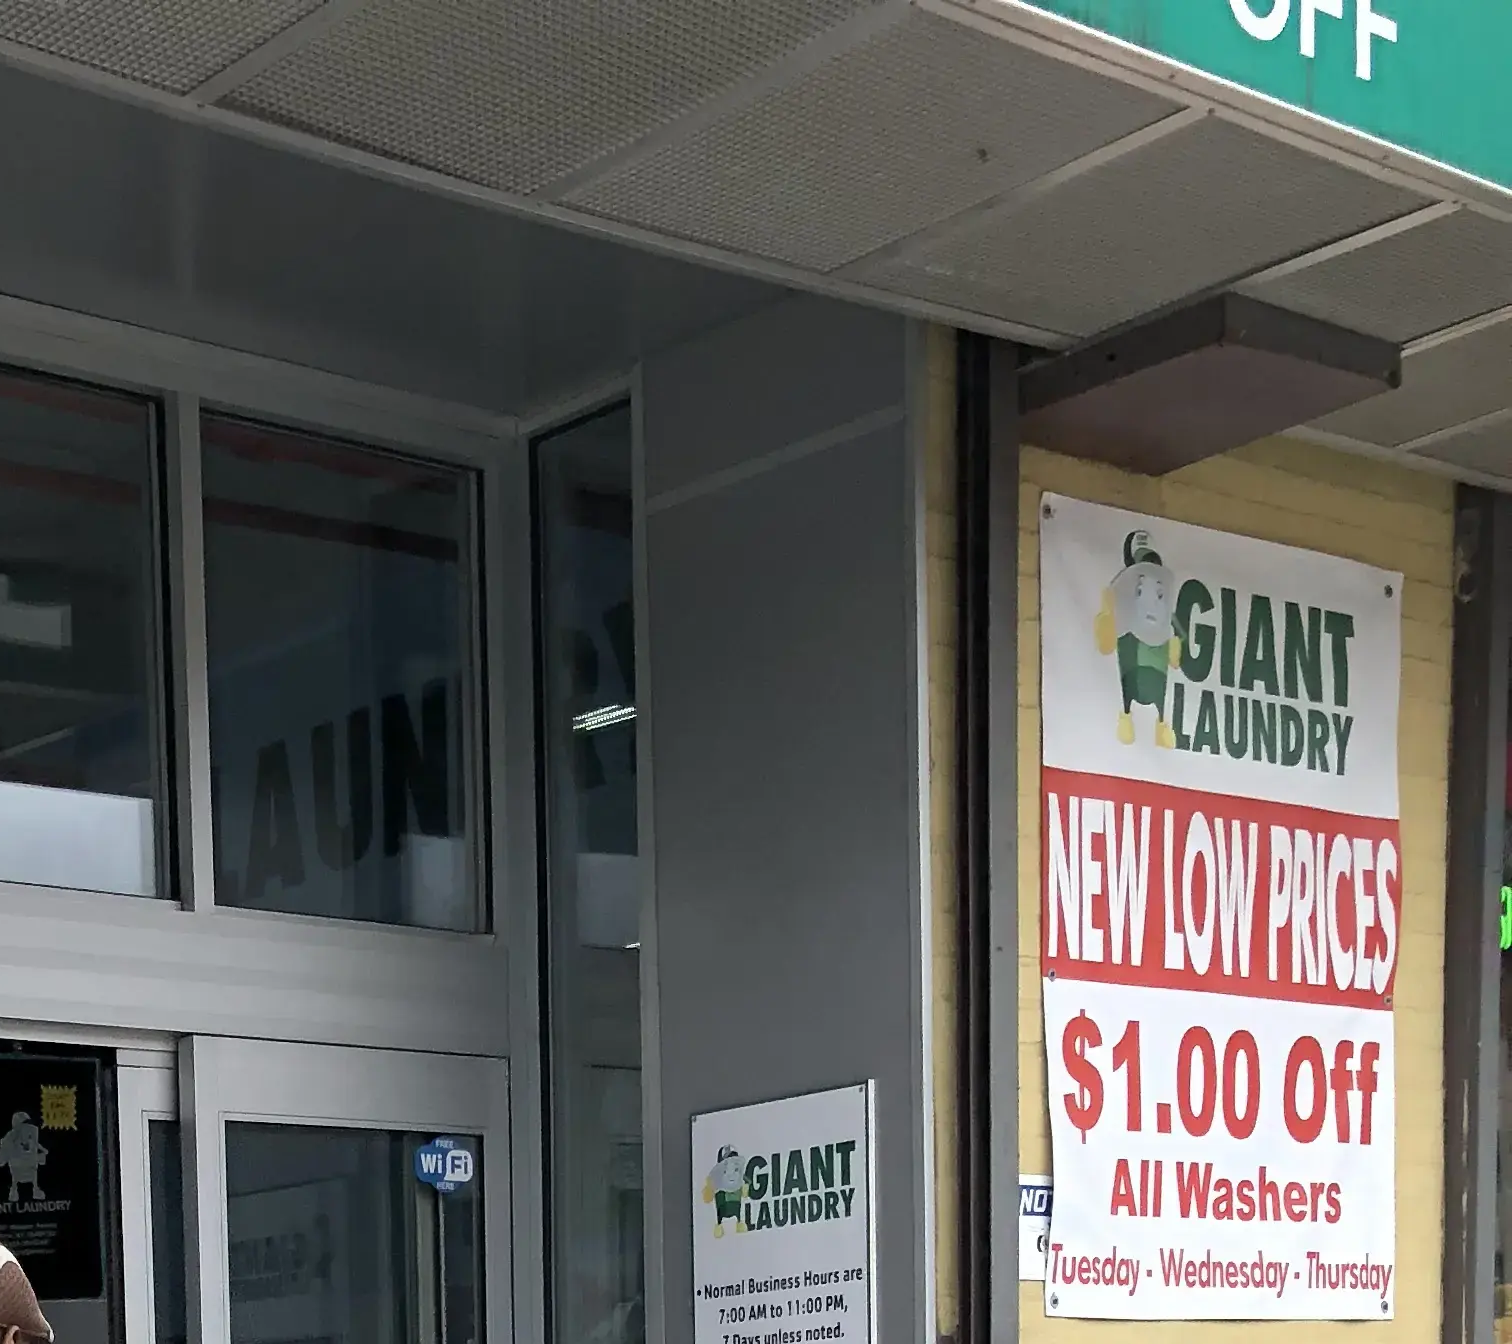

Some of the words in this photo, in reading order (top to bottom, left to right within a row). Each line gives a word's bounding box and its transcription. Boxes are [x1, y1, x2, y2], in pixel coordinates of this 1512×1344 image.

[1174, 579, 1354, 707] GIANT
[1172, 683, 1354, 775] LAUNDRY
[1048, 792, 1151, 966] NEW
[1164, 809, 1258, 978] LOW
[1268, 825, 1398, 994] PRICES
[1062, 1009, 1260, 1144] $1.00
[1284, 1036, 1380, 1146] Off
[745, 1140, 856, 1200] GIANT
[1110, 1158, 1162, 1217] All
[1176, 1161, 1342, 1223] Washers
[16, 1200, 71, 1213] LAUNDRY
[745, 1188, 855, 1231] LAUNDRY
[1019, 1188, 1053, 1215] NO
[704, 1280, 745, 1300] Normal
[748, 1276, 800, 1294] Business
[804, 1270, 839, 1287] Hours
[843, 1267, 863, 1281] are
[1051, 1244, 1141, 1296] Tuesday
[1159, 1248, 1288, 1298] Wednesday
[1306, 1252, 1392, 1299] Thursday
[719, 1308, 746, 1324] 7:00
[749, 1304, 767, 1321] AM
[770, 1304, 783, 1318] to
[787, 1297, 822, 1316] 11:00
